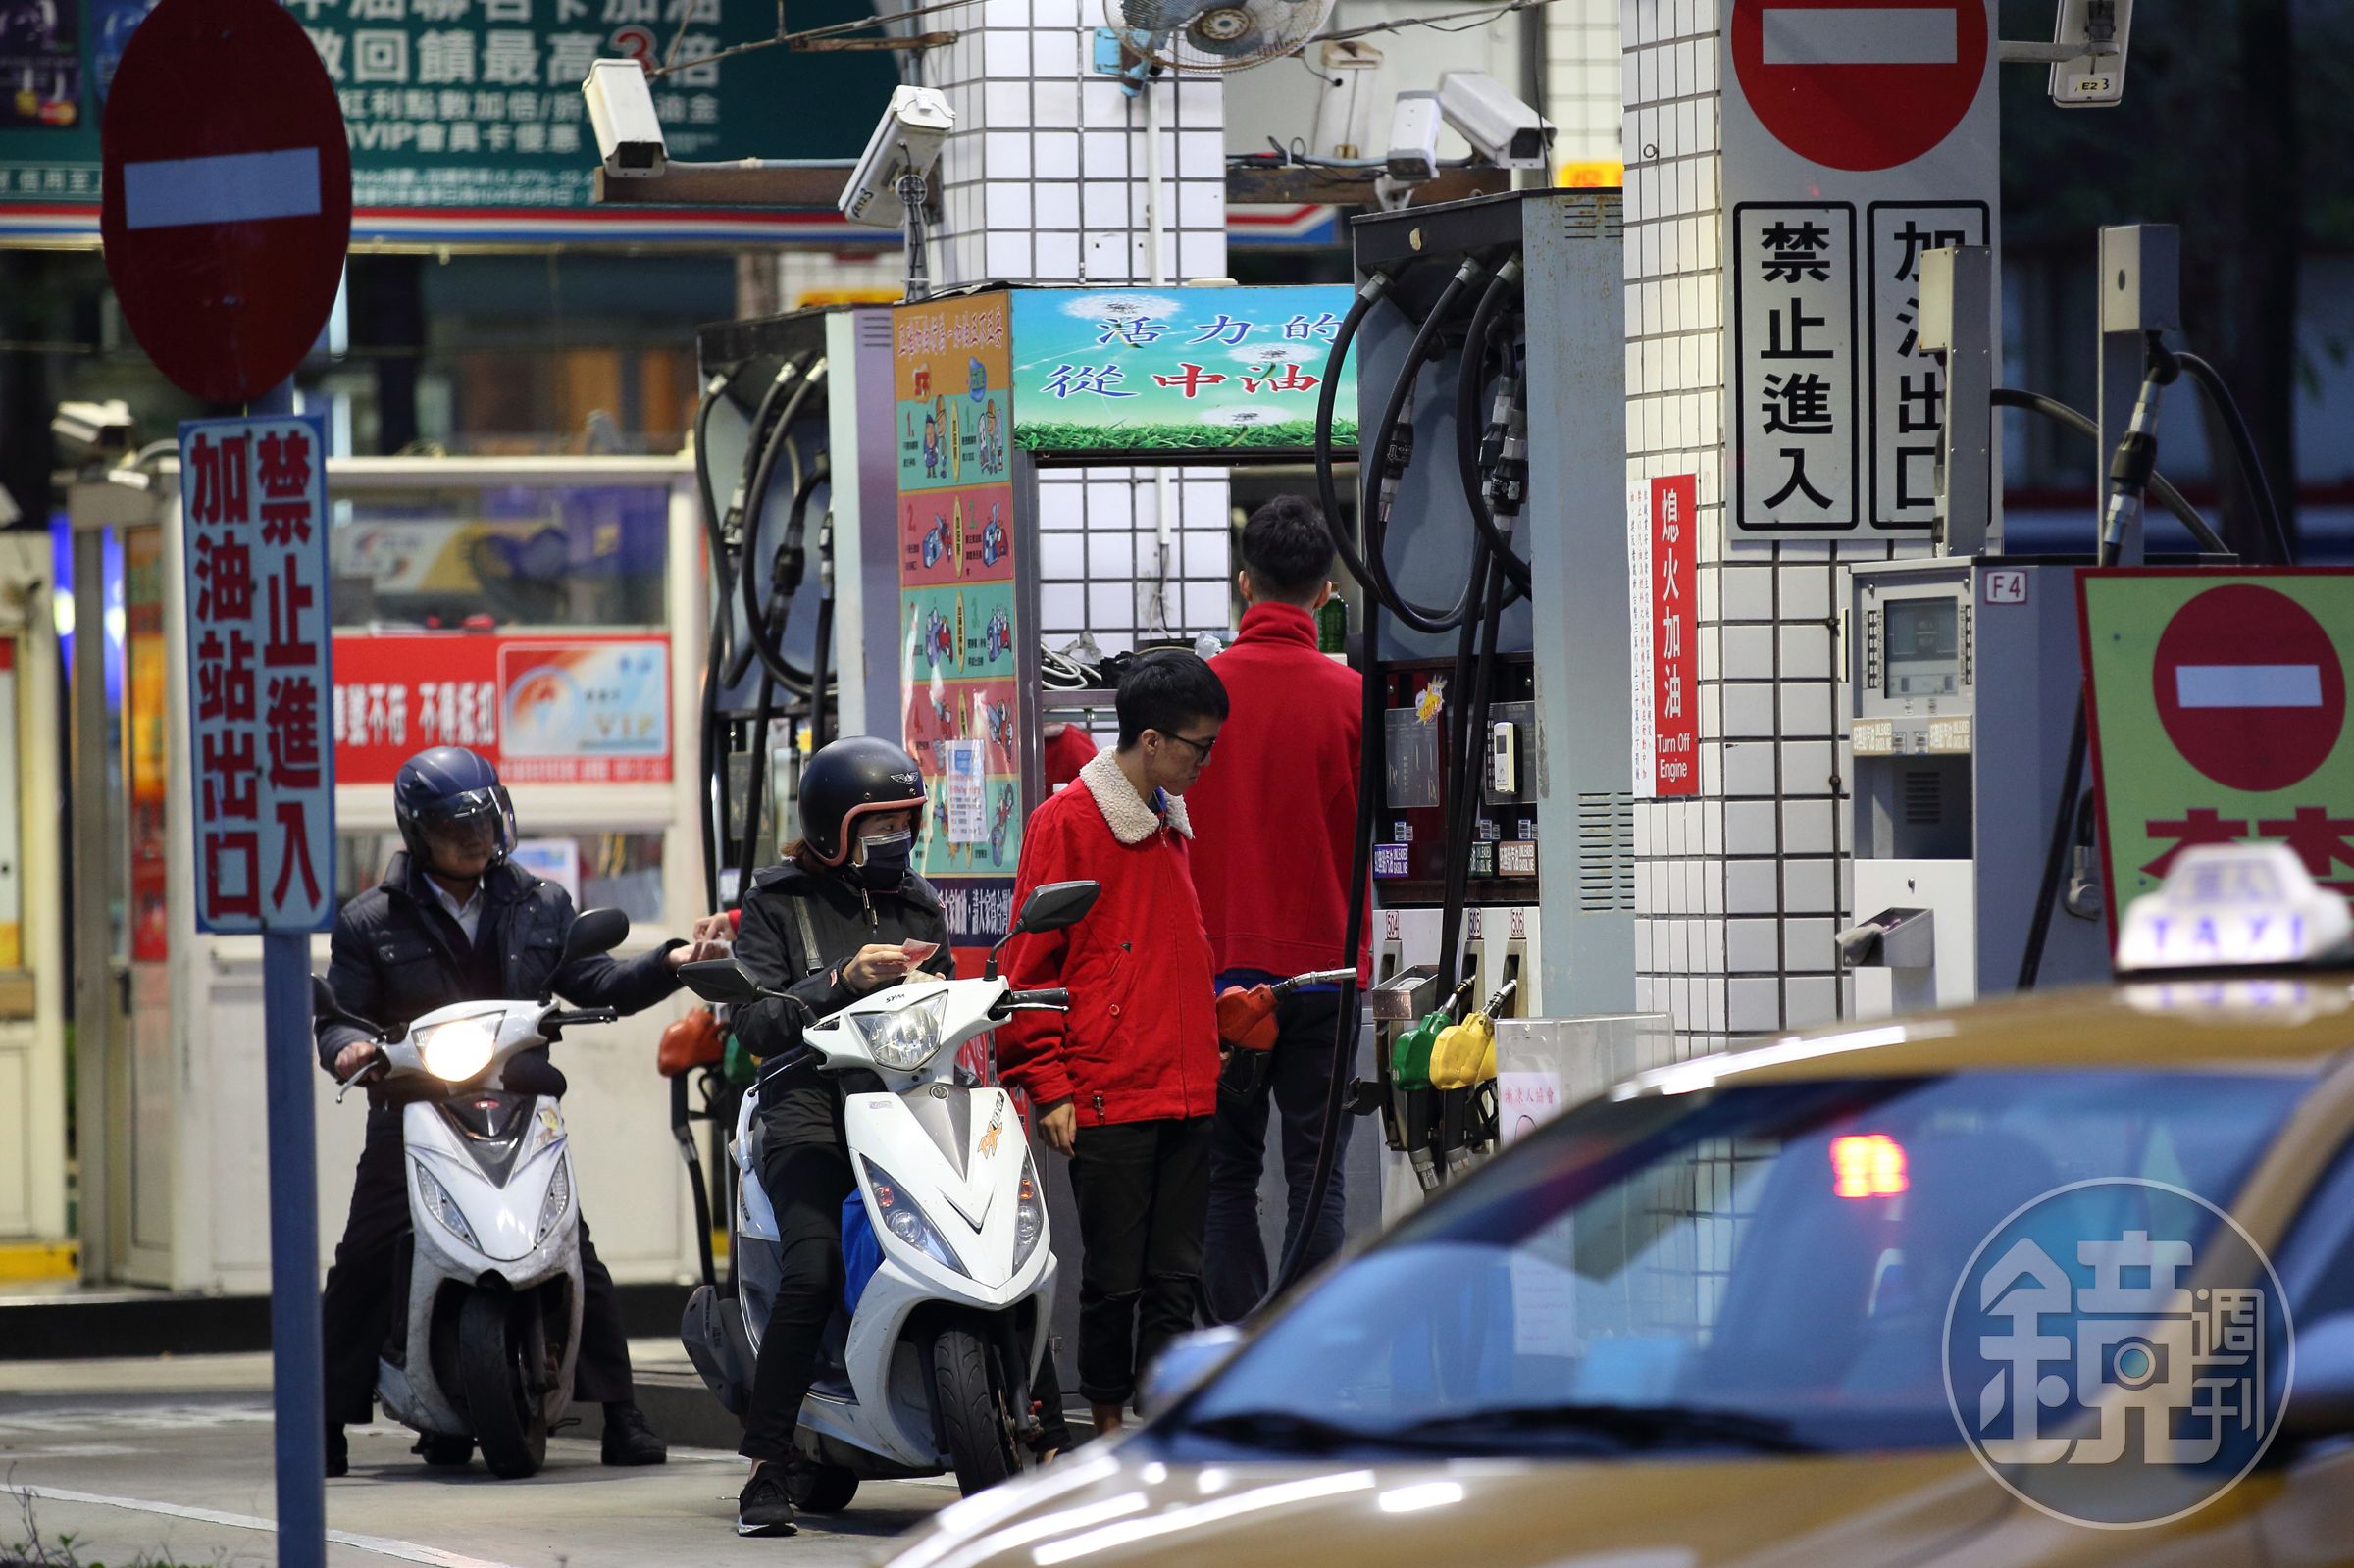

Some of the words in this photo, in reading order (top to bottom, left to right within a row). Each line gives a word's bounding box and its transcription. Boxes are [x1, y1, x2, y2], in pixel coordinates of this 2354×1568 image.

[345, 122, 582, 152] VIP會員卡優惠
[1041, 362, 1321, 400] 從中油
[1761, 221, 1834, 510] 禁止進入
[1893, 220, 1966, 510] 加出口
[1661, 488, 1682, 720] 熄火加油
[1992, 575, 2021, 599] F4
[189, 433, 262, 920] 加油站出口
[256, 429, 322, 912] 禁止進入
[1657, 733, 1676, 754] Turn
[1678, 733, 1691, 753] Off
[1660, 758, 1688, 783] Engine
[886, 992, 905, 1004] SYM
